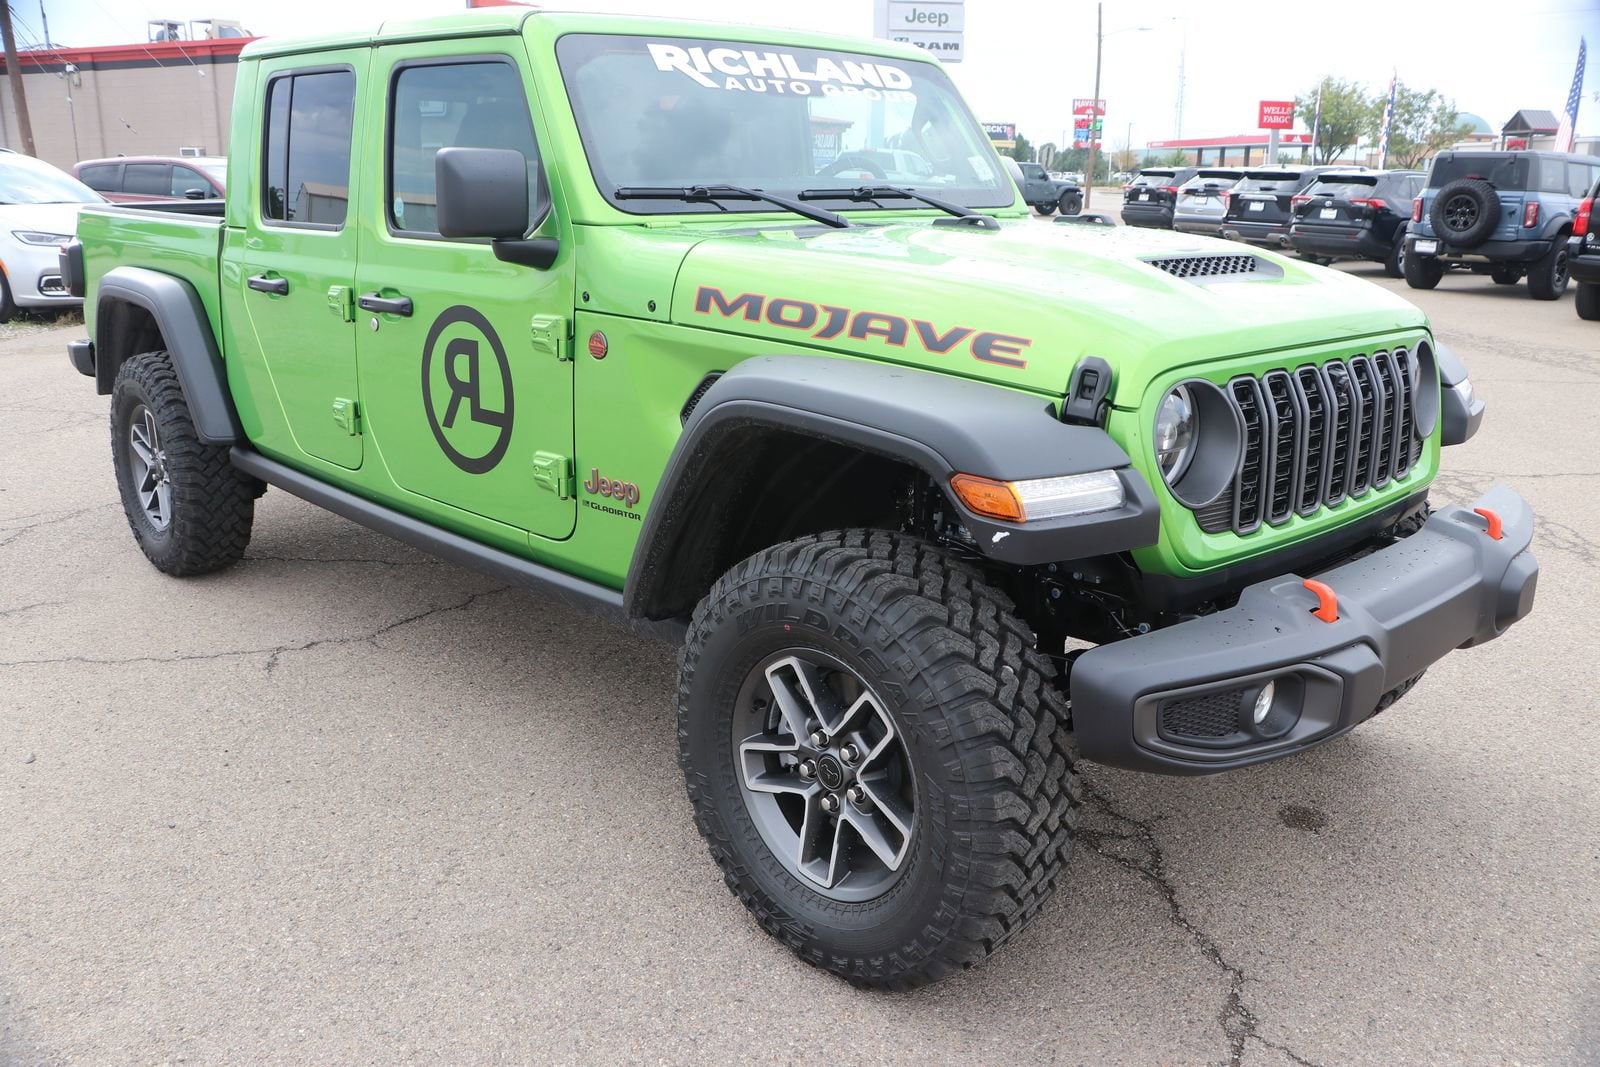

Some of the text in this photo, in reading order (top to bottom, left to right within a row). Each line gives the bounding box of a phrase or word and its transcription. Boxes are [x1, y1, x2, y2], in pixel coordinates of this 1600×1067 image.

[905, 8, 949, 27] Jeep
[913, 41, 960, 51] RAM
[646, 43, 913, 91] RICHLAND
[725, 77, 917, 105] AUTO GROUP
[1263, 106, 1293, 115] WELLS
[694, 284, 1032, 370] MOJAVE
[583, 466, 640, 510] Jeep
[590, 501, 642, 522] GLADIATOR
